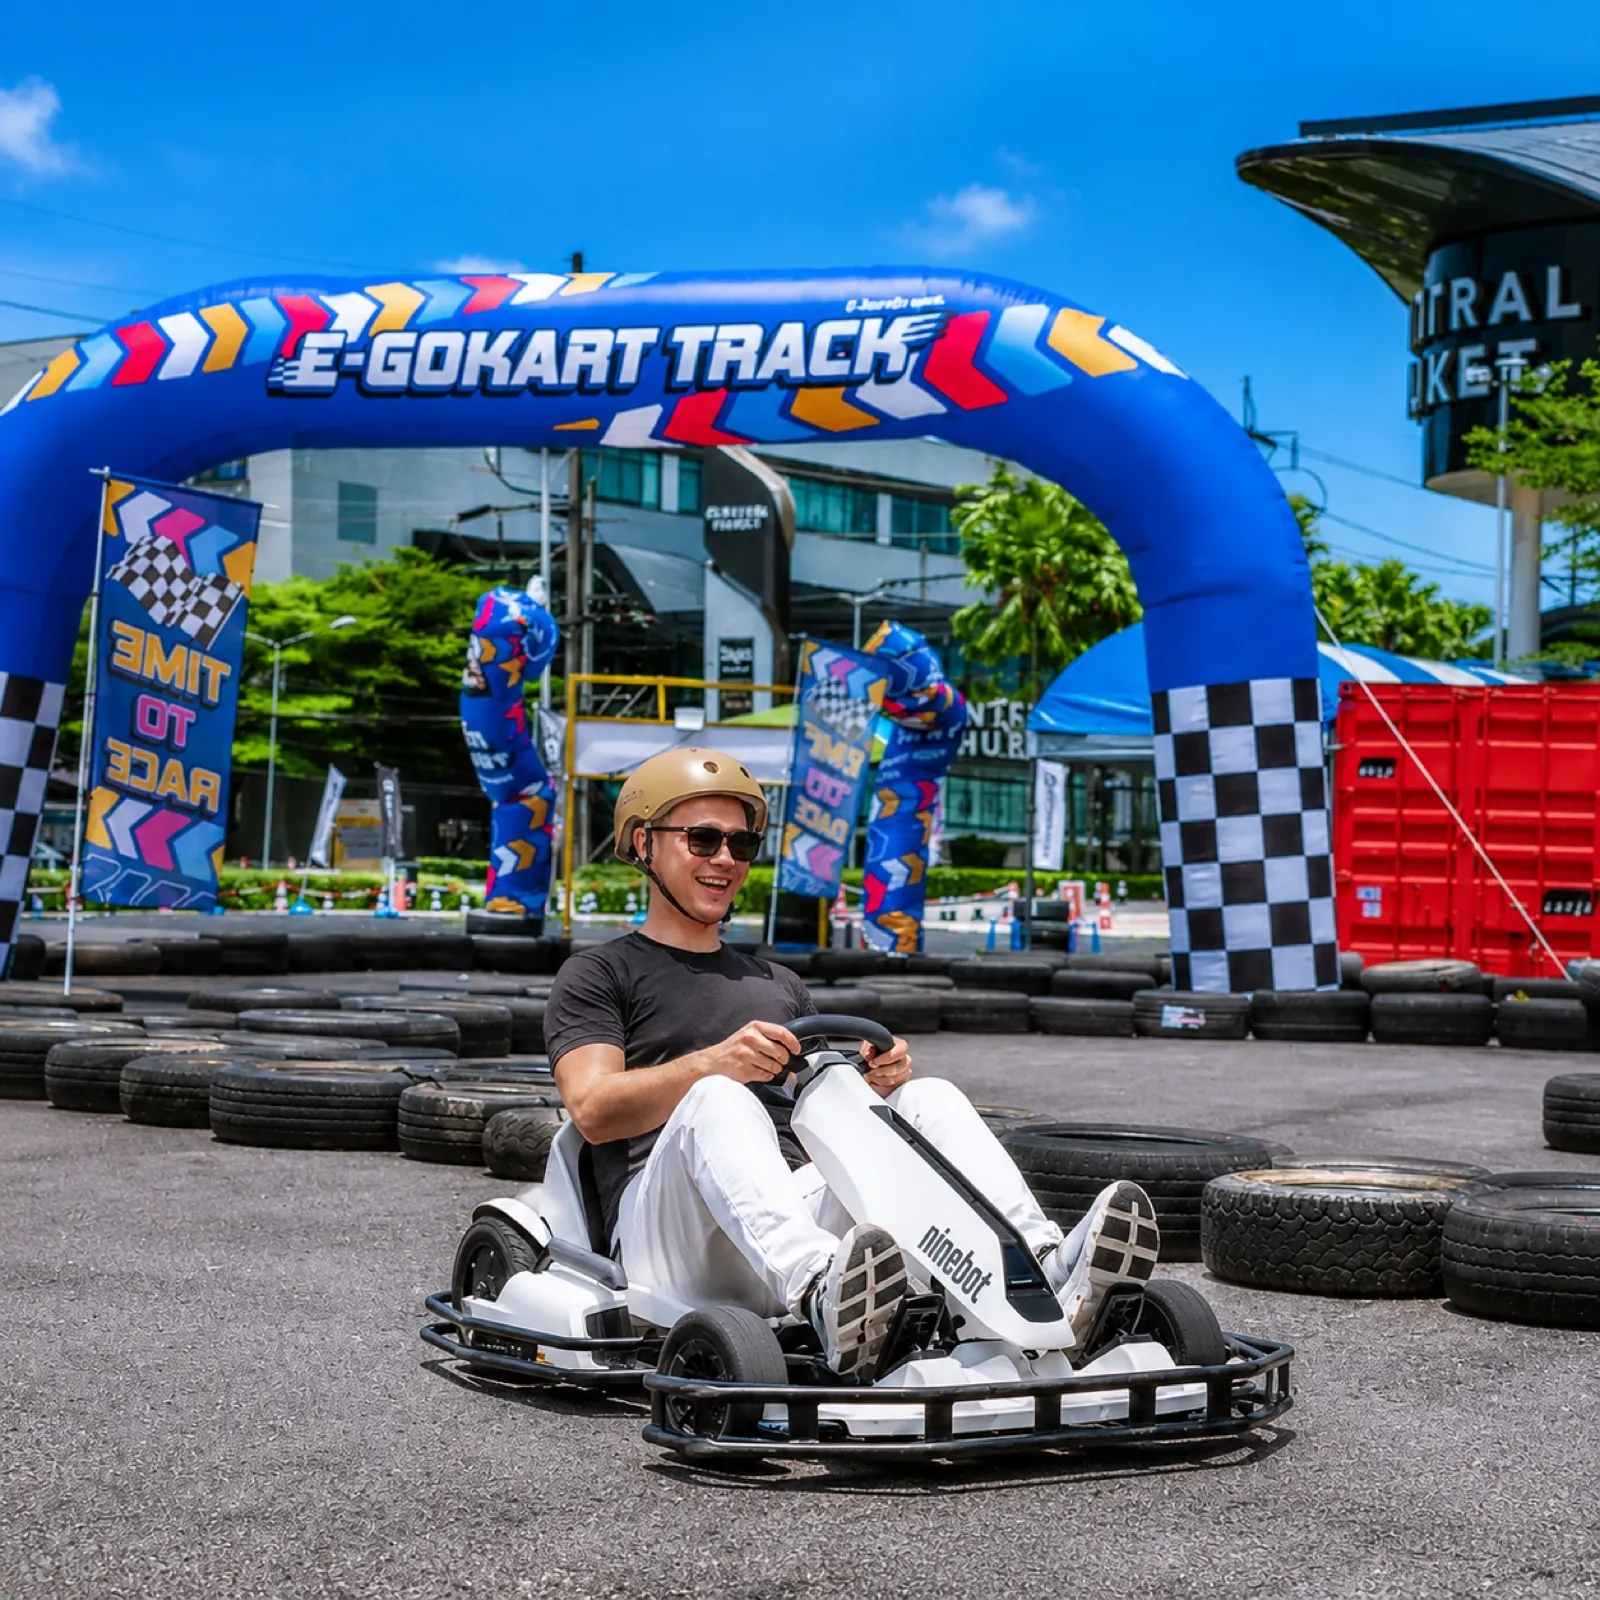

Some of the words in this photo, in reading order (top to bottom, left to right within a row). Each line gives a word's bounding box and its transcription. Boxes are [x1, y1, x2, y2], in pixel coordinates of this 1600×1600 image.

[278, 327, 658, 391] E-GOKART
[672, 313, 940, 387] TRACK
[917, 1225, 993, 1304] ninebot
